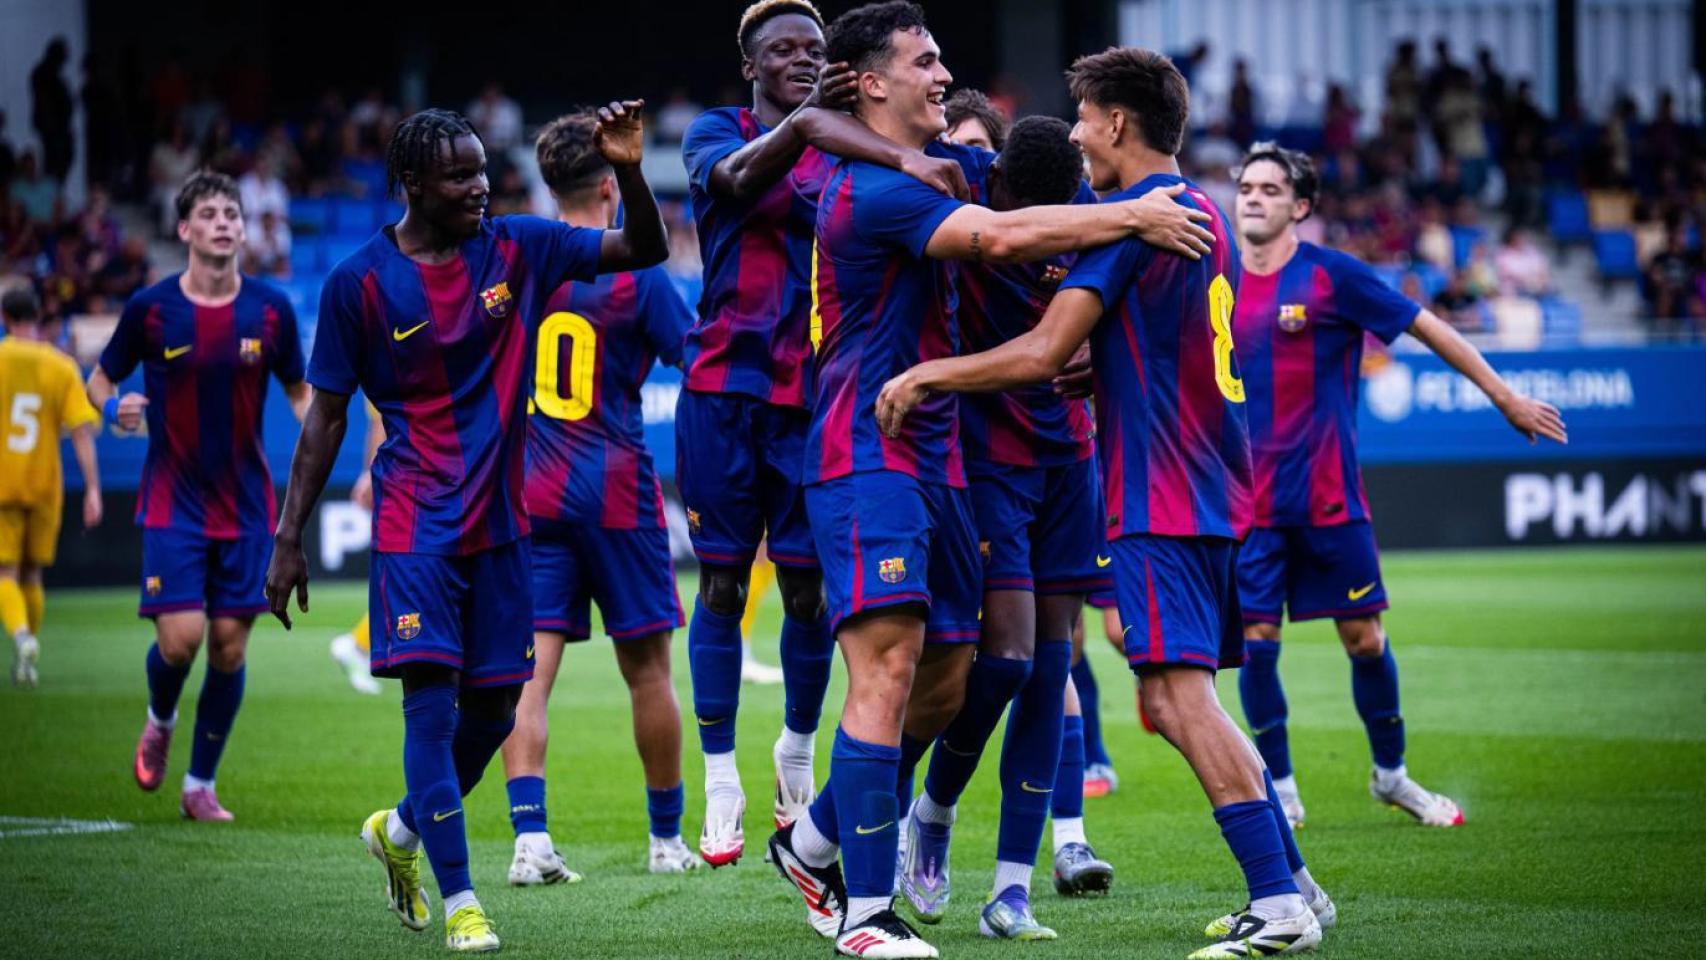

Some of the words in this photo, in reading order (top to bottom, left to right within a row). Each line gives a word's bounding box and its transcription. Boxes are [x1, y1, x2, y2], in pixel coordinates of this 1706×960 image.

[527, 311, 596, 421] 0
[1208, 273, 1246, 403] 8
[7, 392, 42, 453] 5
